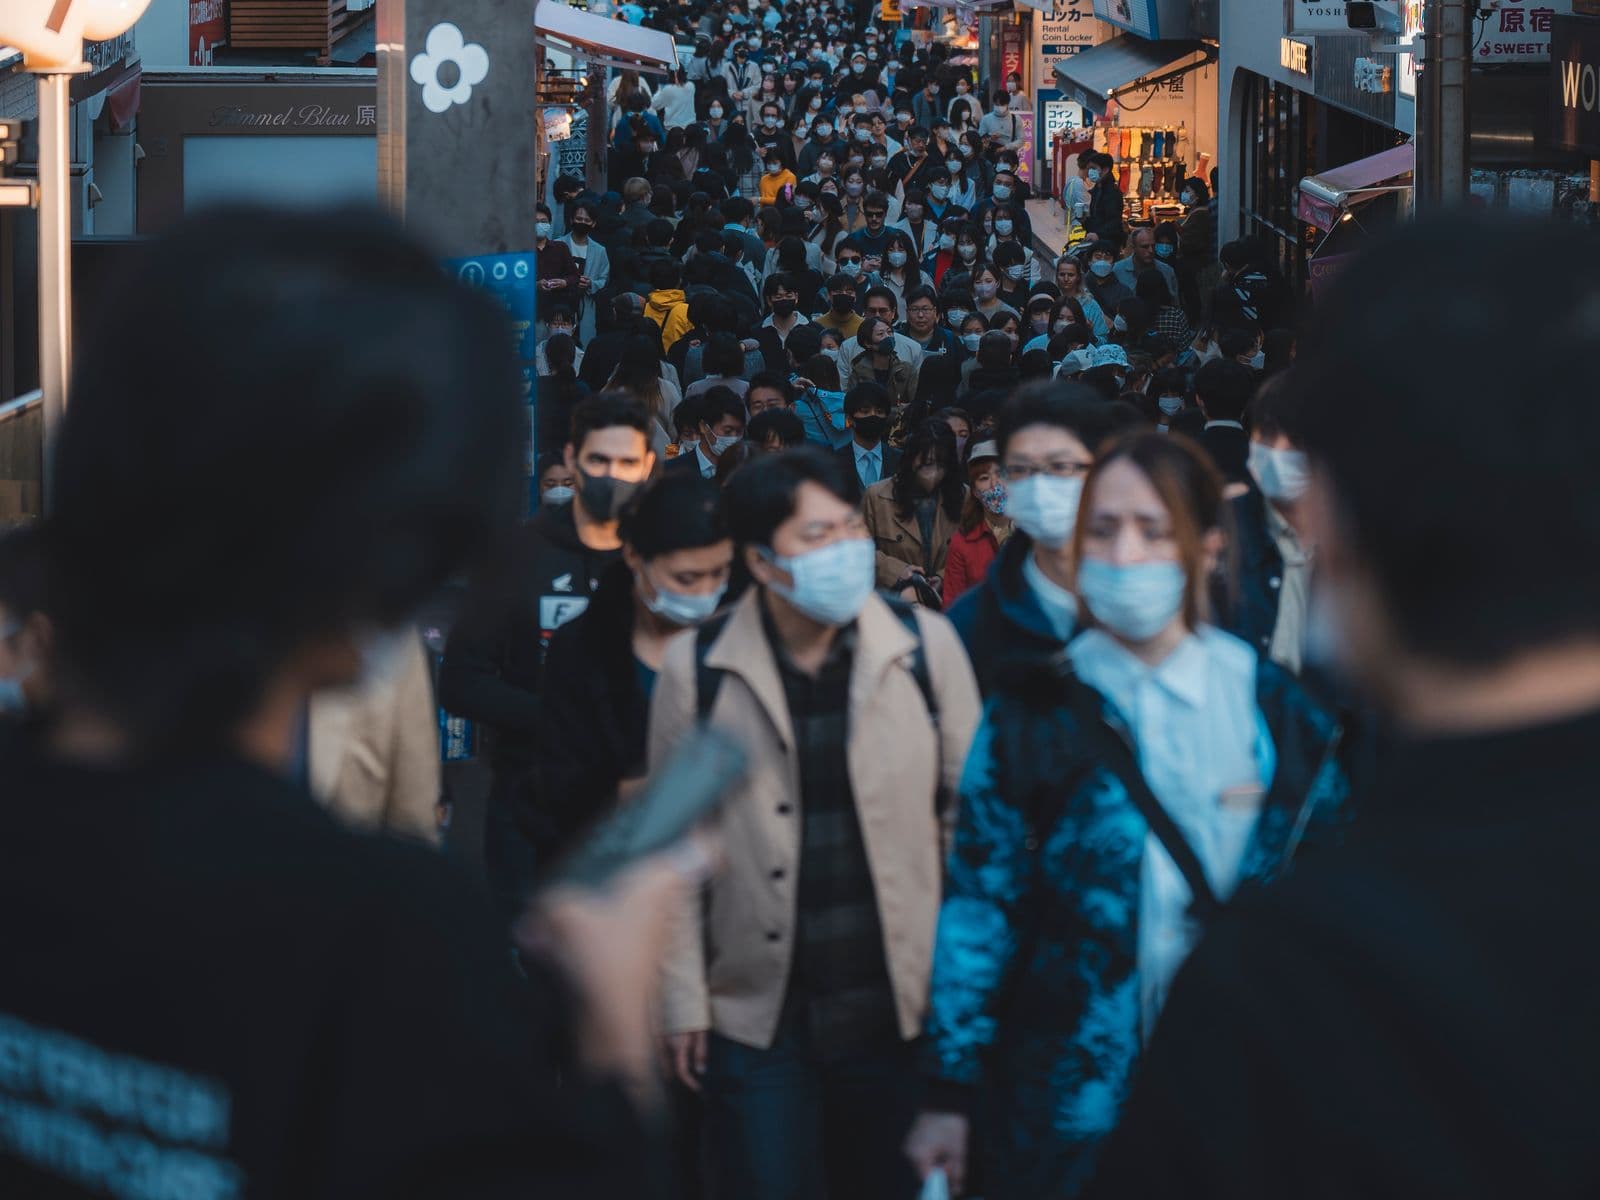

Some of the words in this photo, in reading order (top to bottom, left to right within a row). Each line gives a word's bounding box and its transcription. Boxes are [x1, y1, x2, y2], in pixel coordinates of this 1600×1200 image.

[1042, 25, 1070, 33] Rental
[1494, 43, 1542, 54] SWEET
[1560, 60, 1600, 112] WO
[295, 104, 351, 127] Blau
[1048, 110, 1073, 119] コイン
